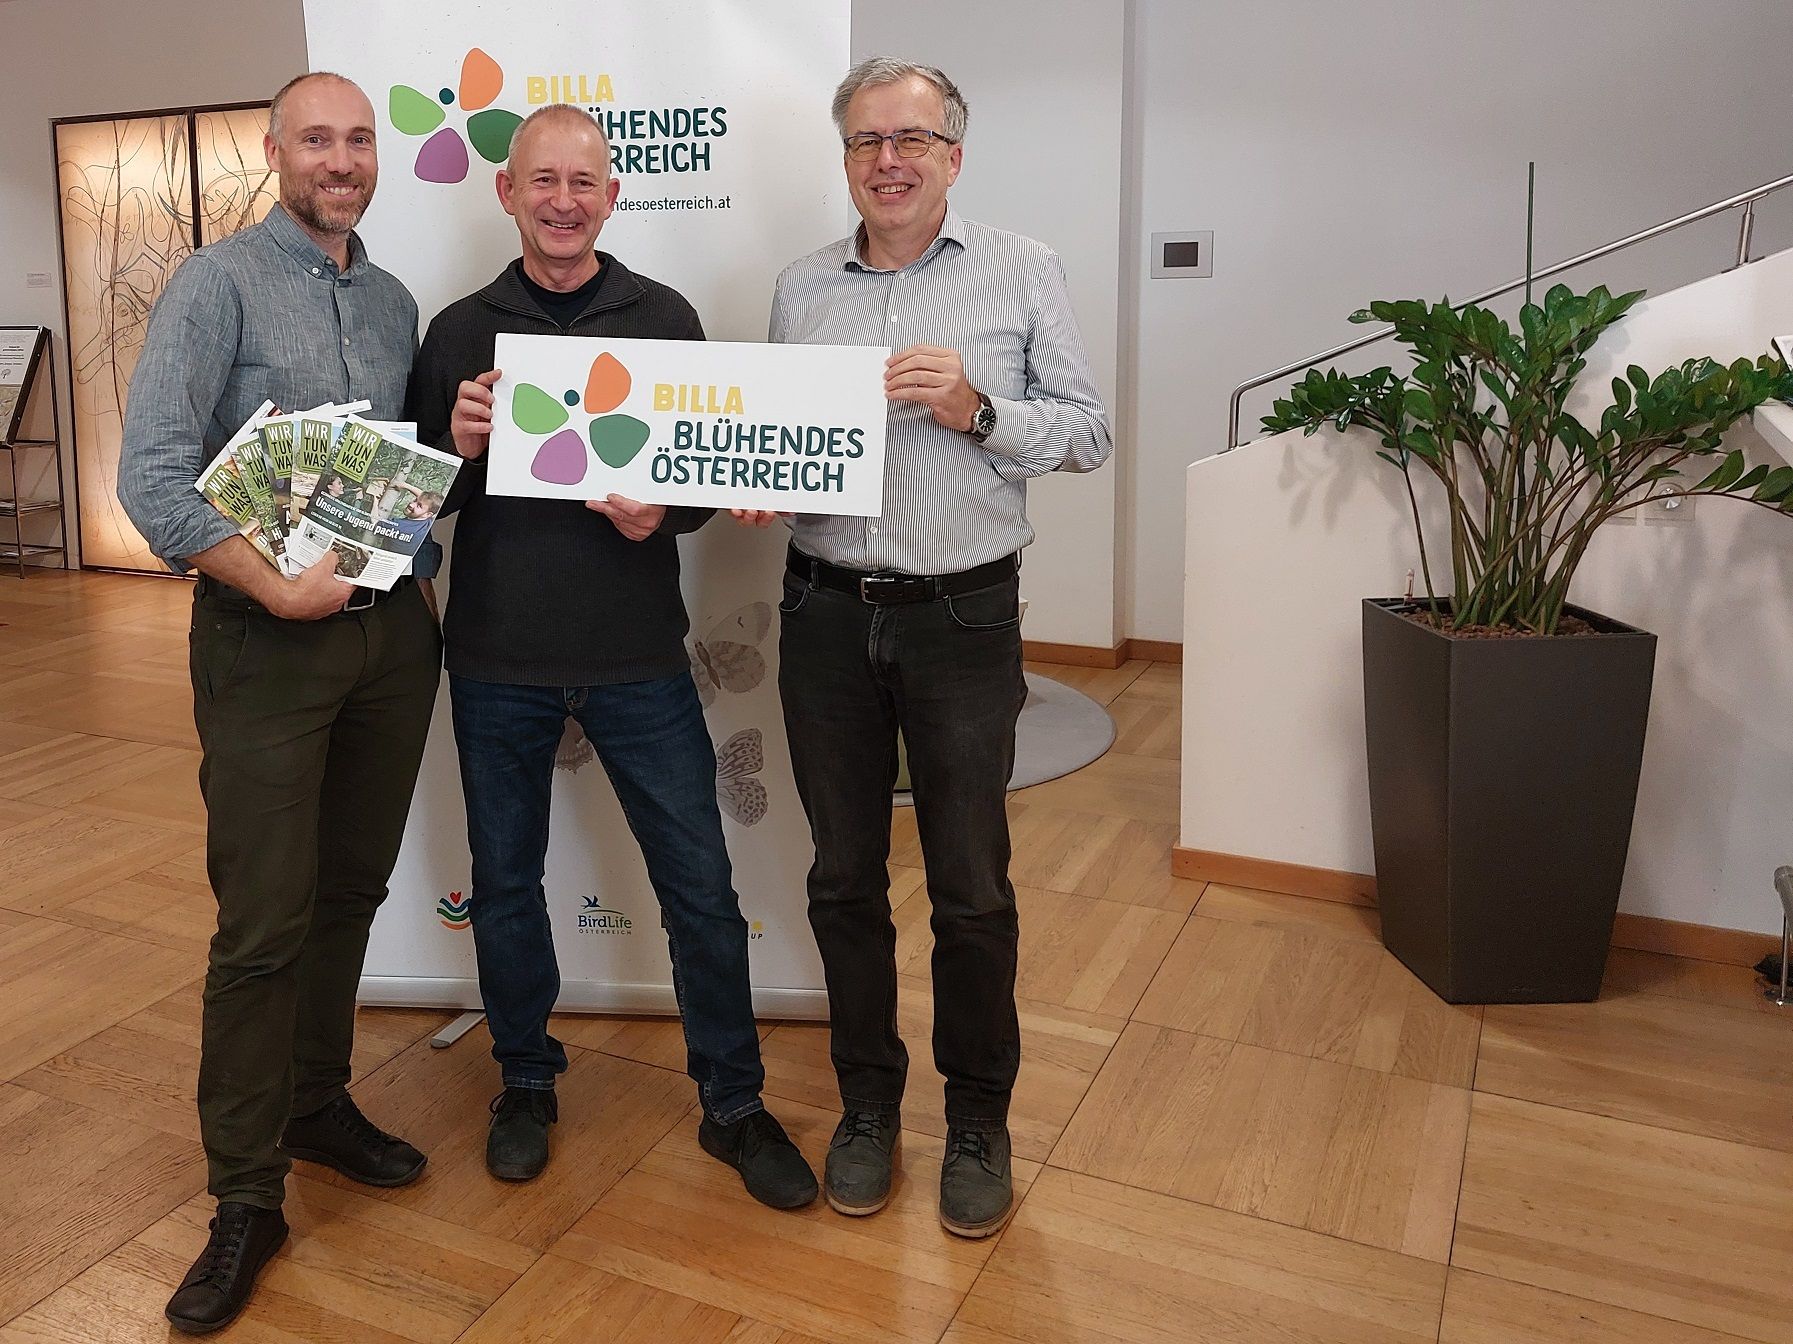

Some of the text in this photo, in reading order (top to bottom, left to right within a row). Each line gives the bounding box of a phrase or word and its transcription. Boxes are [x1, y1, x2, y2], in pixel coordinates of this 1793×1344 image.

[527, 74, 615, 104] BILLA
[588, 106, 728, 139] HENDES
[609, 142, 711, 174] RREICH
[613, 196, 731, 211] ndesoesterreich.at
[653, 383, 745, 415] BILLA
[267, 424, 292, 441] WIR
[304, 422, 329, 440] WIR
[352, 425, 378, 449] WIR
[674, 418, 865, 459] BLÜHENDES
[240, 442, 264, 462] WIR
[304, 437, 328, 454] TUN
[347, 438, 372, 462] TUN
[274, 454, 293, 471] WA
[303, 451, 327, 468] WAS
[340, 451, 366, 474] WAS
[651, 446, 845, 493] ÖSTERREICH
[207, 469, 231, 495] WIR
[218, 480, 242, 505] TUN
[252, 473, 271, 490] WA
[229, 491, 252, 516] WAS
[315, 496, 344, 518] Unsere
[343, 511, 374, 531] Jugend
[373, 525, 399, 539] packt
[398, 532, 414, 543] an!
[577, 914, 632, 929] BirdLife
